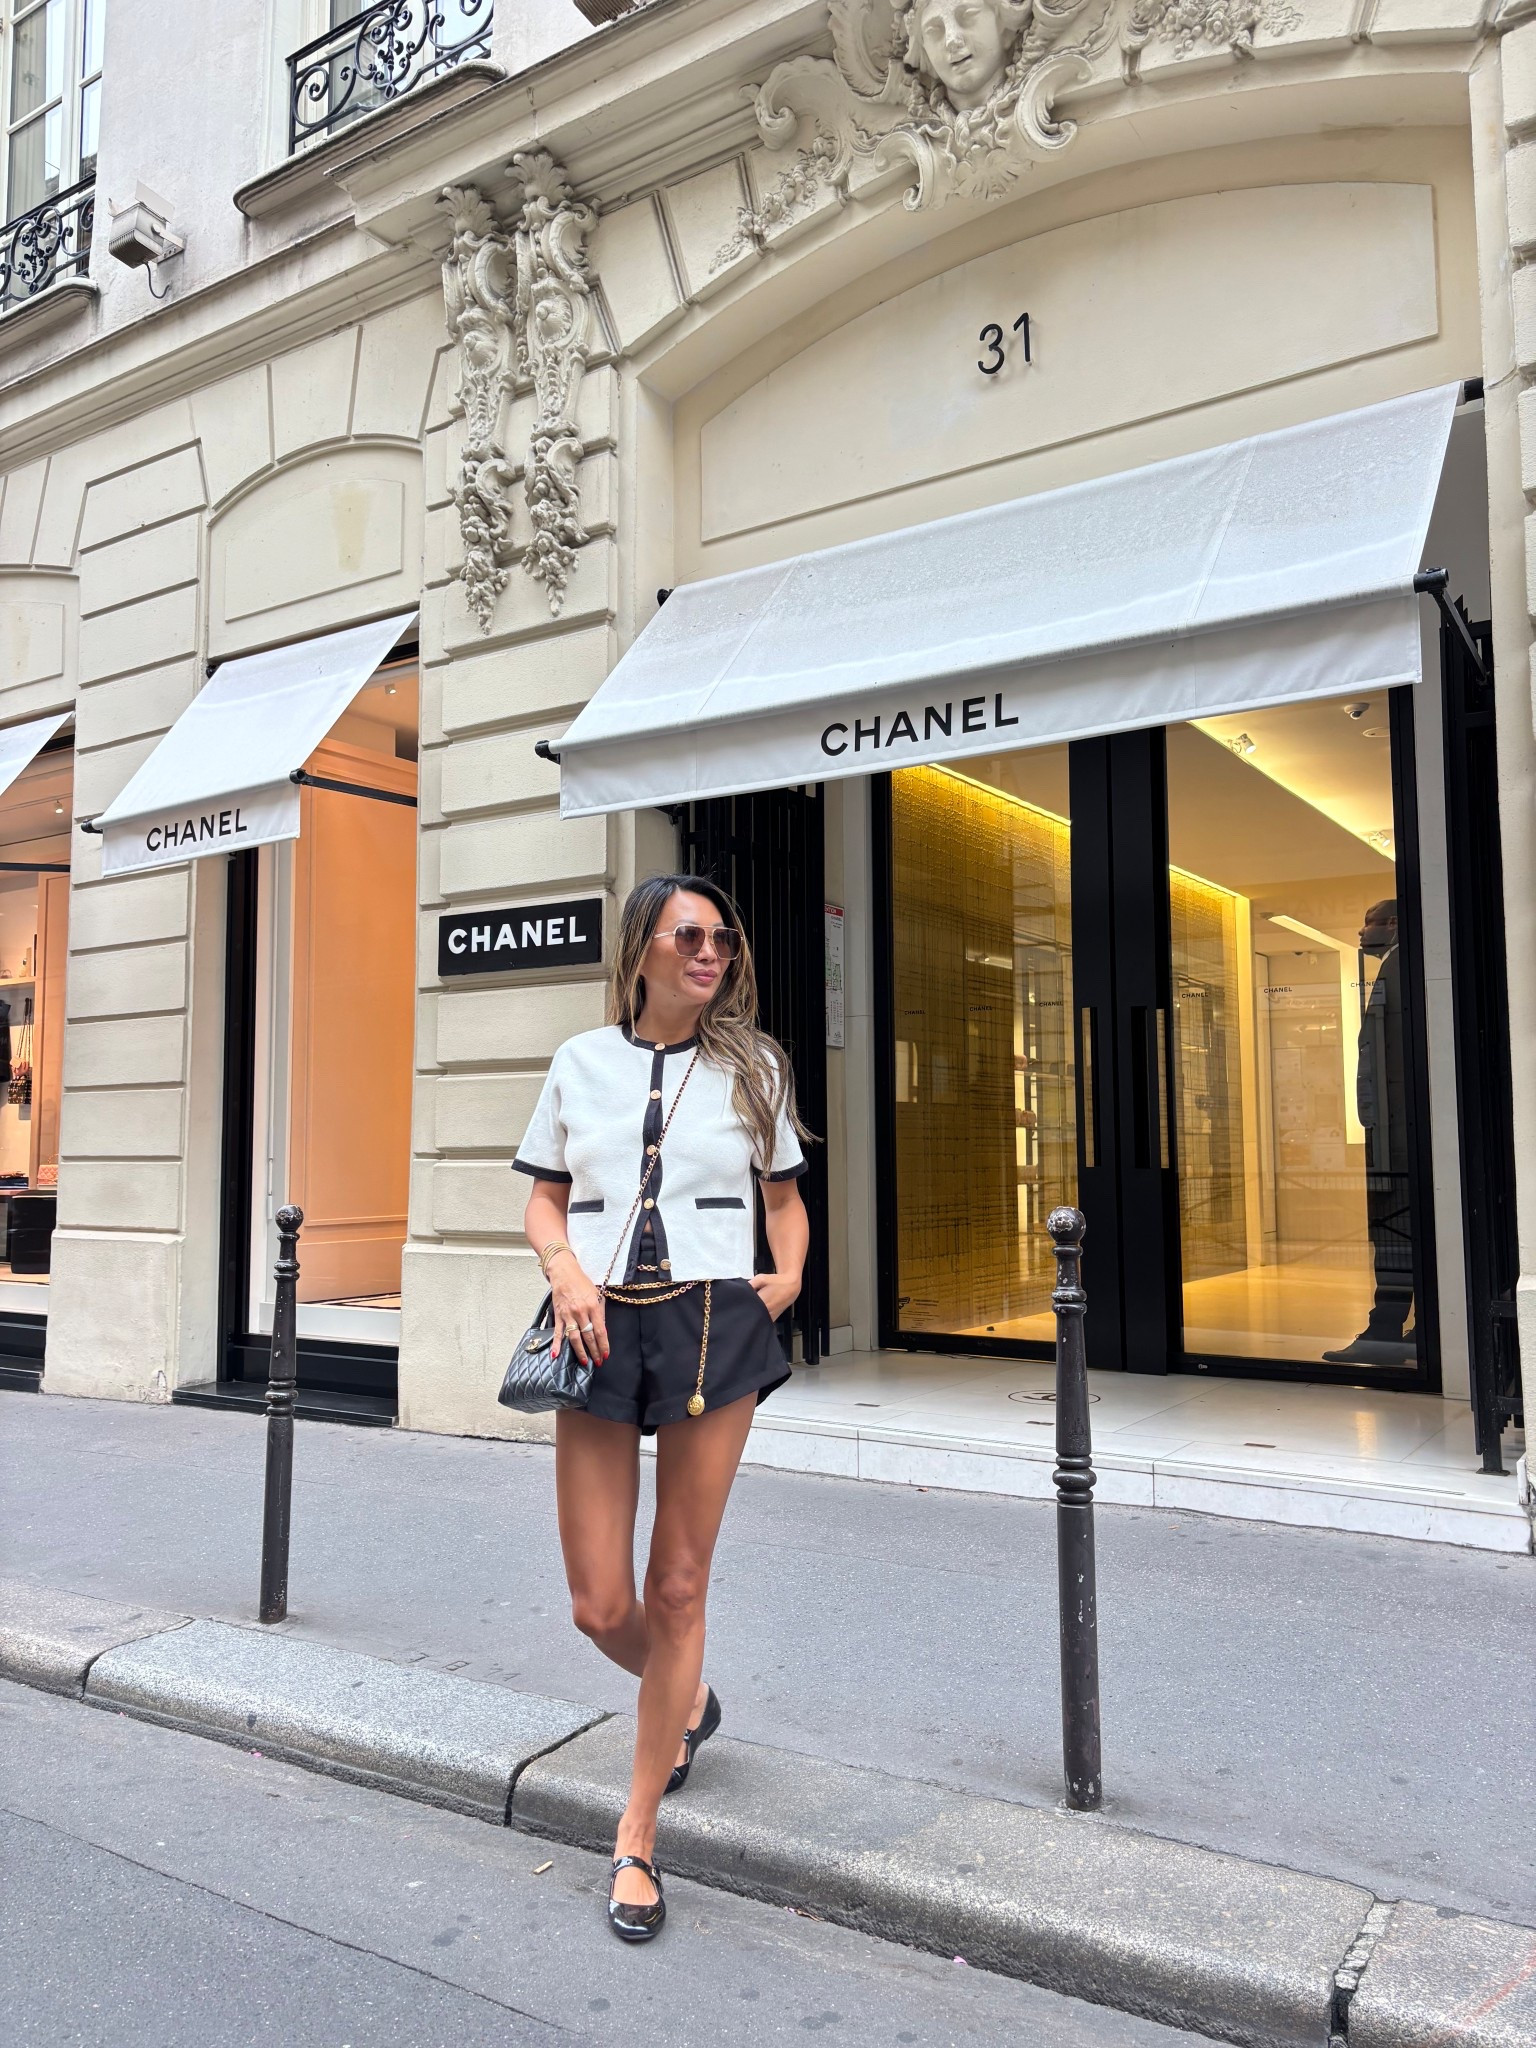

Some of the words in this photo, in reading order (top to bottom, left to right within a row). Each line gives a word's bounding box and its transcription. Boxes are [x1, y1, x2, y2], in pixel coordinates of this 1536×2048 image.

[978, 312, 1030, 374] 31
[821, 693, 1019, 756] CHANEL
[146, 808, 248, 852] CHANEL
[447, 916, 587, 955] CHANEL
[1181, 991, 1209, 999] CHANEL
[1263, 986, 1293, 995] CHANEL
[969, 1005, 993, 1013] CHANEL
[1039, 1000, 1064, 1008] CHANEL
